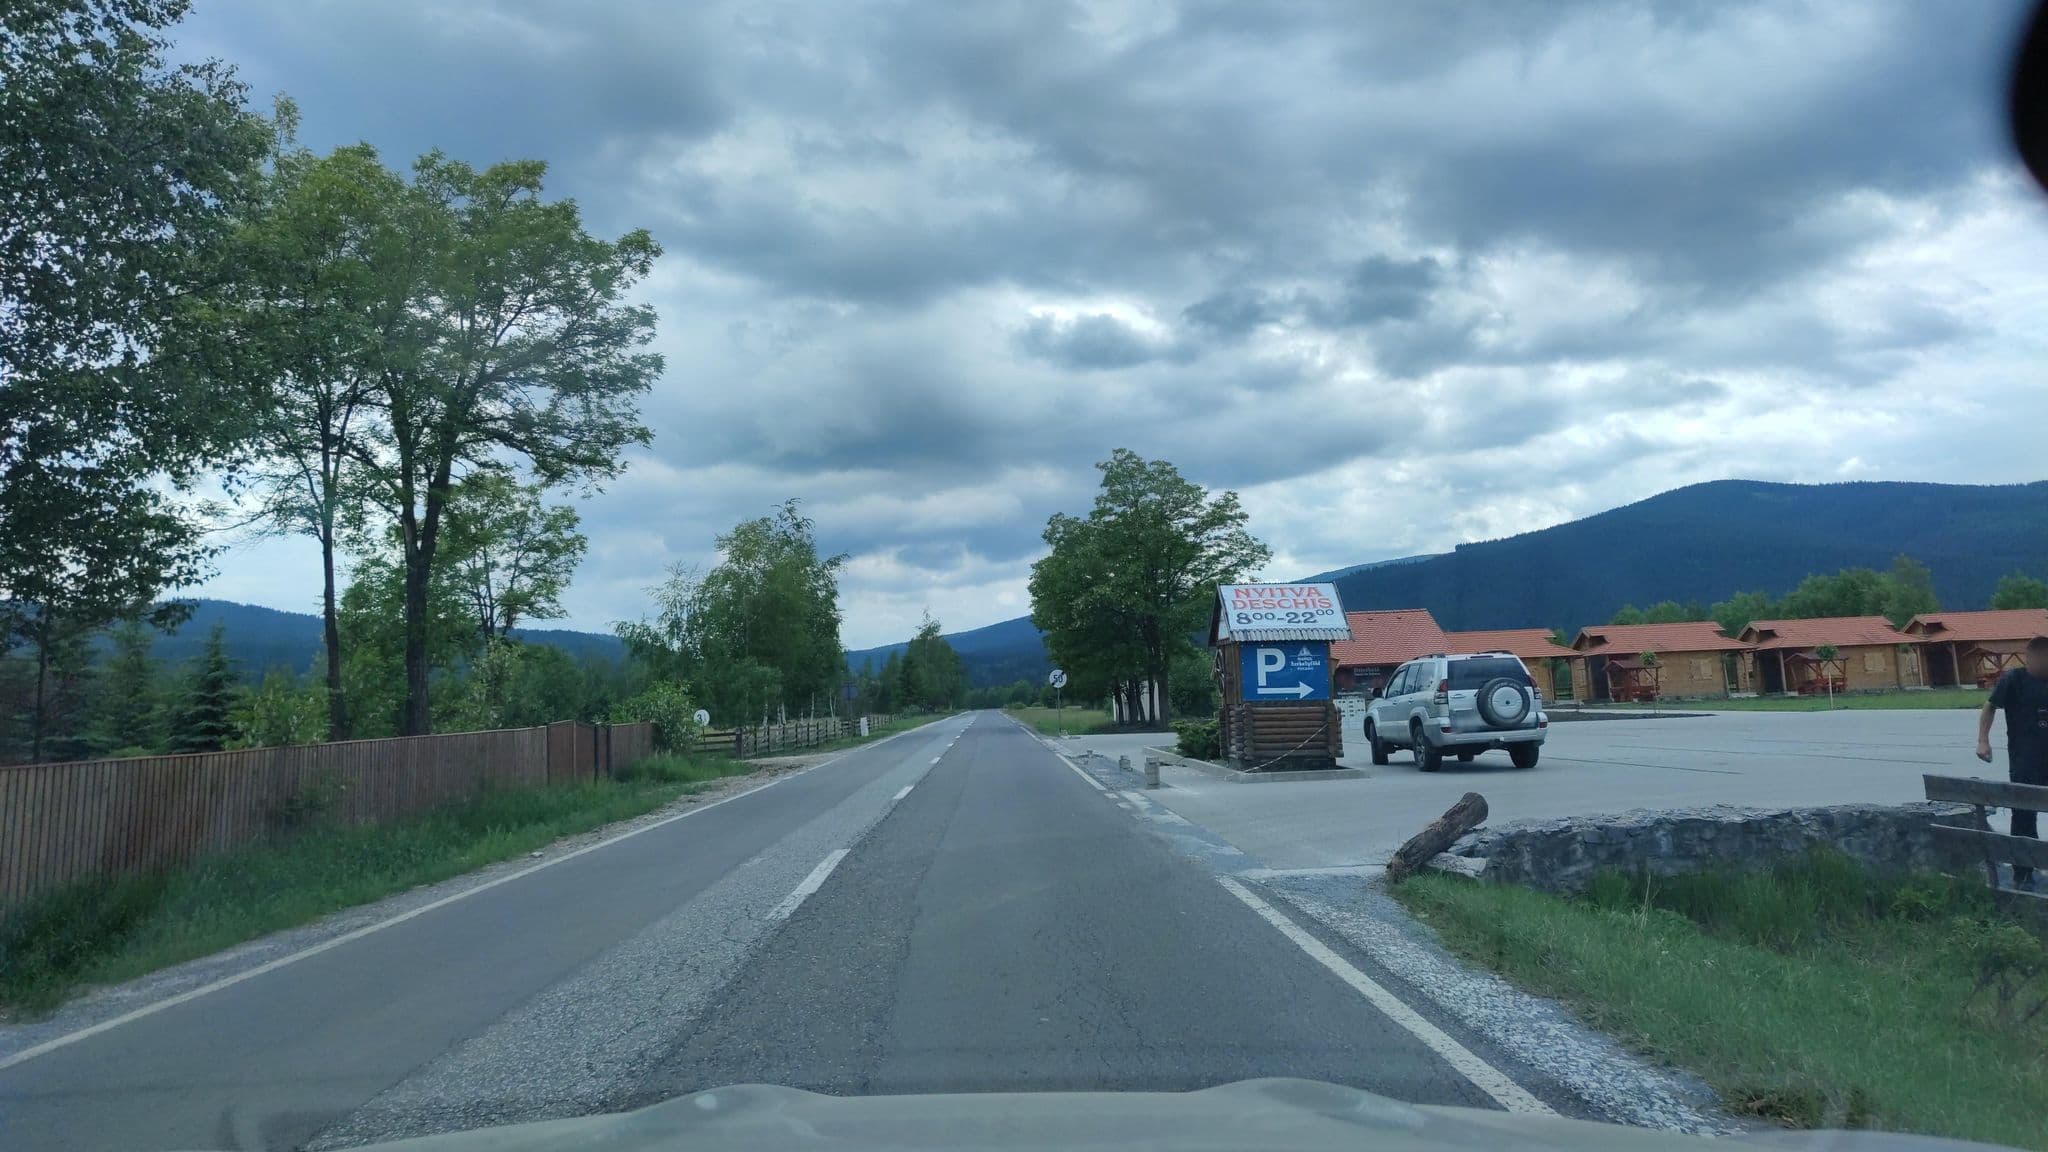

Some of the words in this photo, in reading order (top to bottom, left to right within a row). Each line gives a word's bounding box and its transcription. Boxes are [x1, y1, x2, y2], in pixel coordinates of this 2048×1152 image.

[1233, 586, 1323, 598] NYITVA
[1232, 598, 1332, 610] DESCHIS
[1256, 648, 1286, 687] P
[1053, 674, 1063, 683] 50
